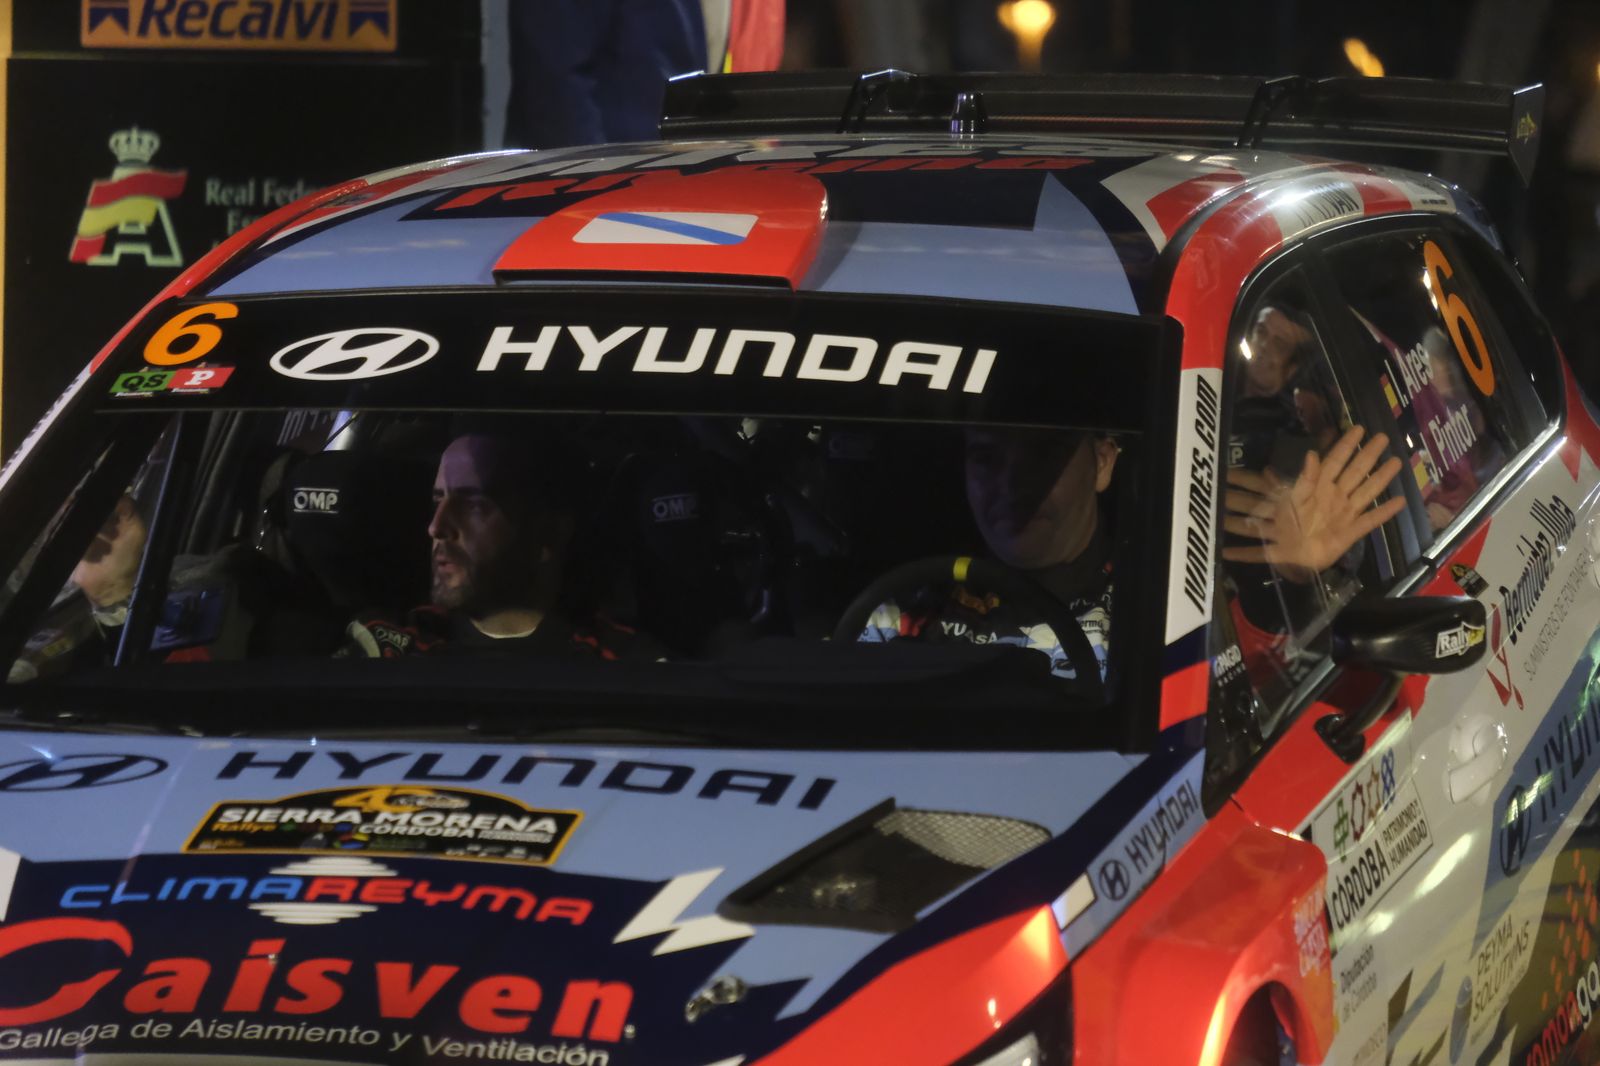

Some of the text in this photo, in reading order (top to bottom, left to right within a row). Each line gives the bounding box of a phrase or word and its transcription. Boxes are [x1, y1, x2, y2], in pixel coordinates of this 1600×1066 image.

[206, 179, 255, 206] Real
[143, 301, 239, 366] 6
[1424, 240, 1496, 396] 6
[121, 373, 168, 392] QS
[476, 326, 998, 394] HYUNDAI
[1395, 343, 1434, 400] Ares
[1428, 404, 1477, 472] Pintor
[293, 491, 339, 511] OMP
[940, 620, 999, 646] YUASA
[215, 750, 837, 810] HYUNDAI
[218, 807, 559, 834] SIERRA MORENA
[1123, 779, 1200, 875] HYUNDAI
[1331, 840, 1391, 929] CÓRDOBA
[0, 1017, 610, 1066] Gallega de Aislamiento y Ventilación
